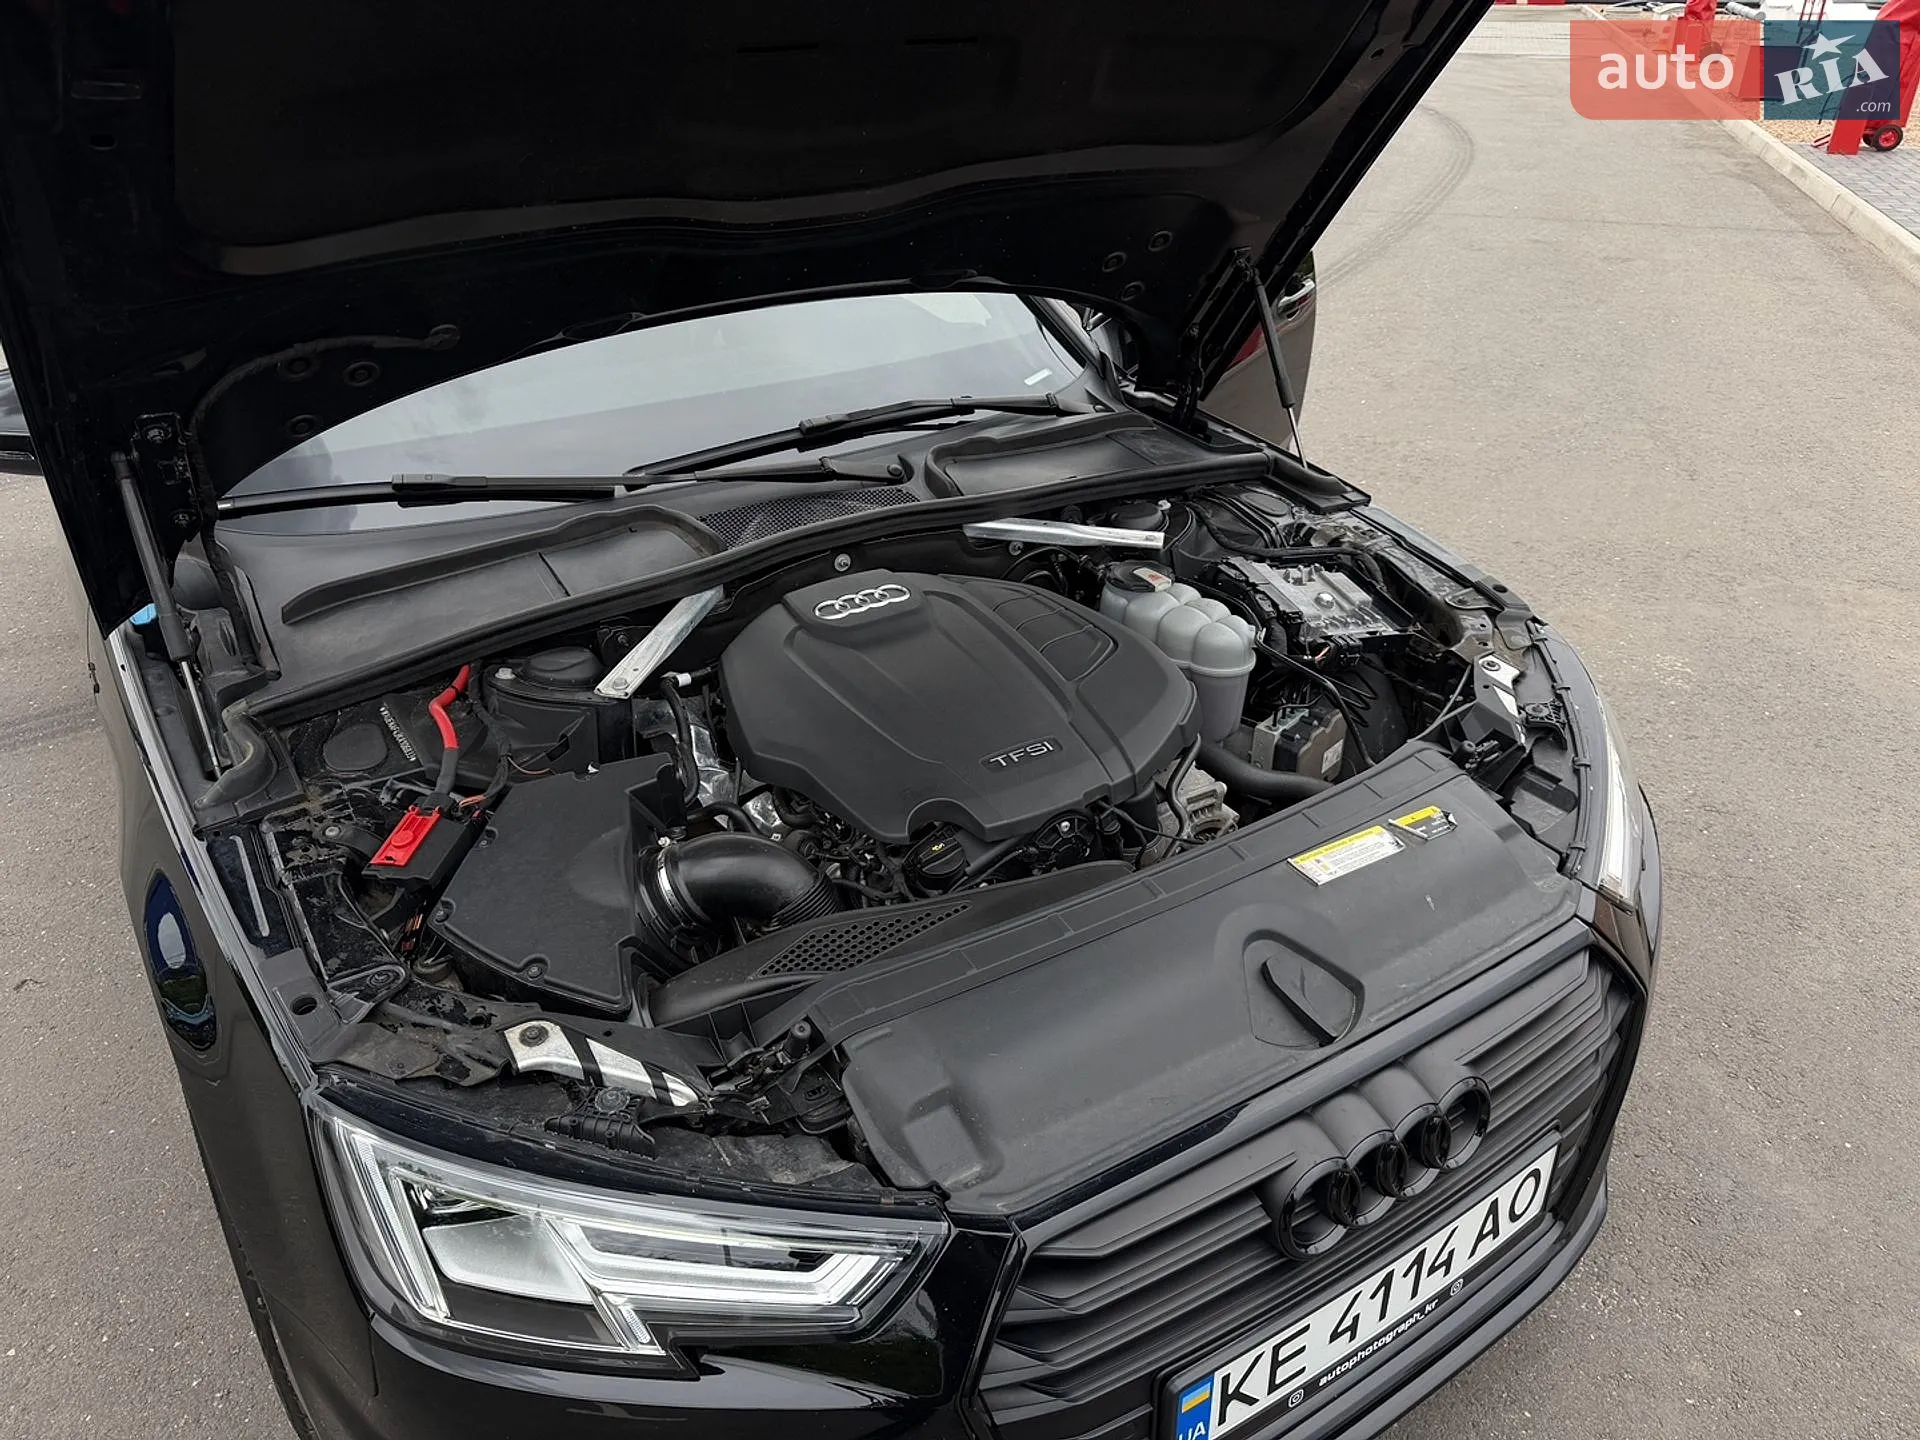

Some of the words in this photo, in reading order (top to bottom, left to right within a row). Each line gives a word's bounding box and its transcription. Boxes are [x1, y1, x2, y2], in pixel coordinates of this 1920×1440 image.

[989, 741, 1053, 767] TFSI
[1217, 1324, 1311, 1427] KE
[1328, 1223, 1456, 1345] 4114
[1467, 1167, 1541, 1260] AO
[1319, 1299, 1439, 1387] autophotograph_kr
[1178, 1421, 1206, 1440] UA
